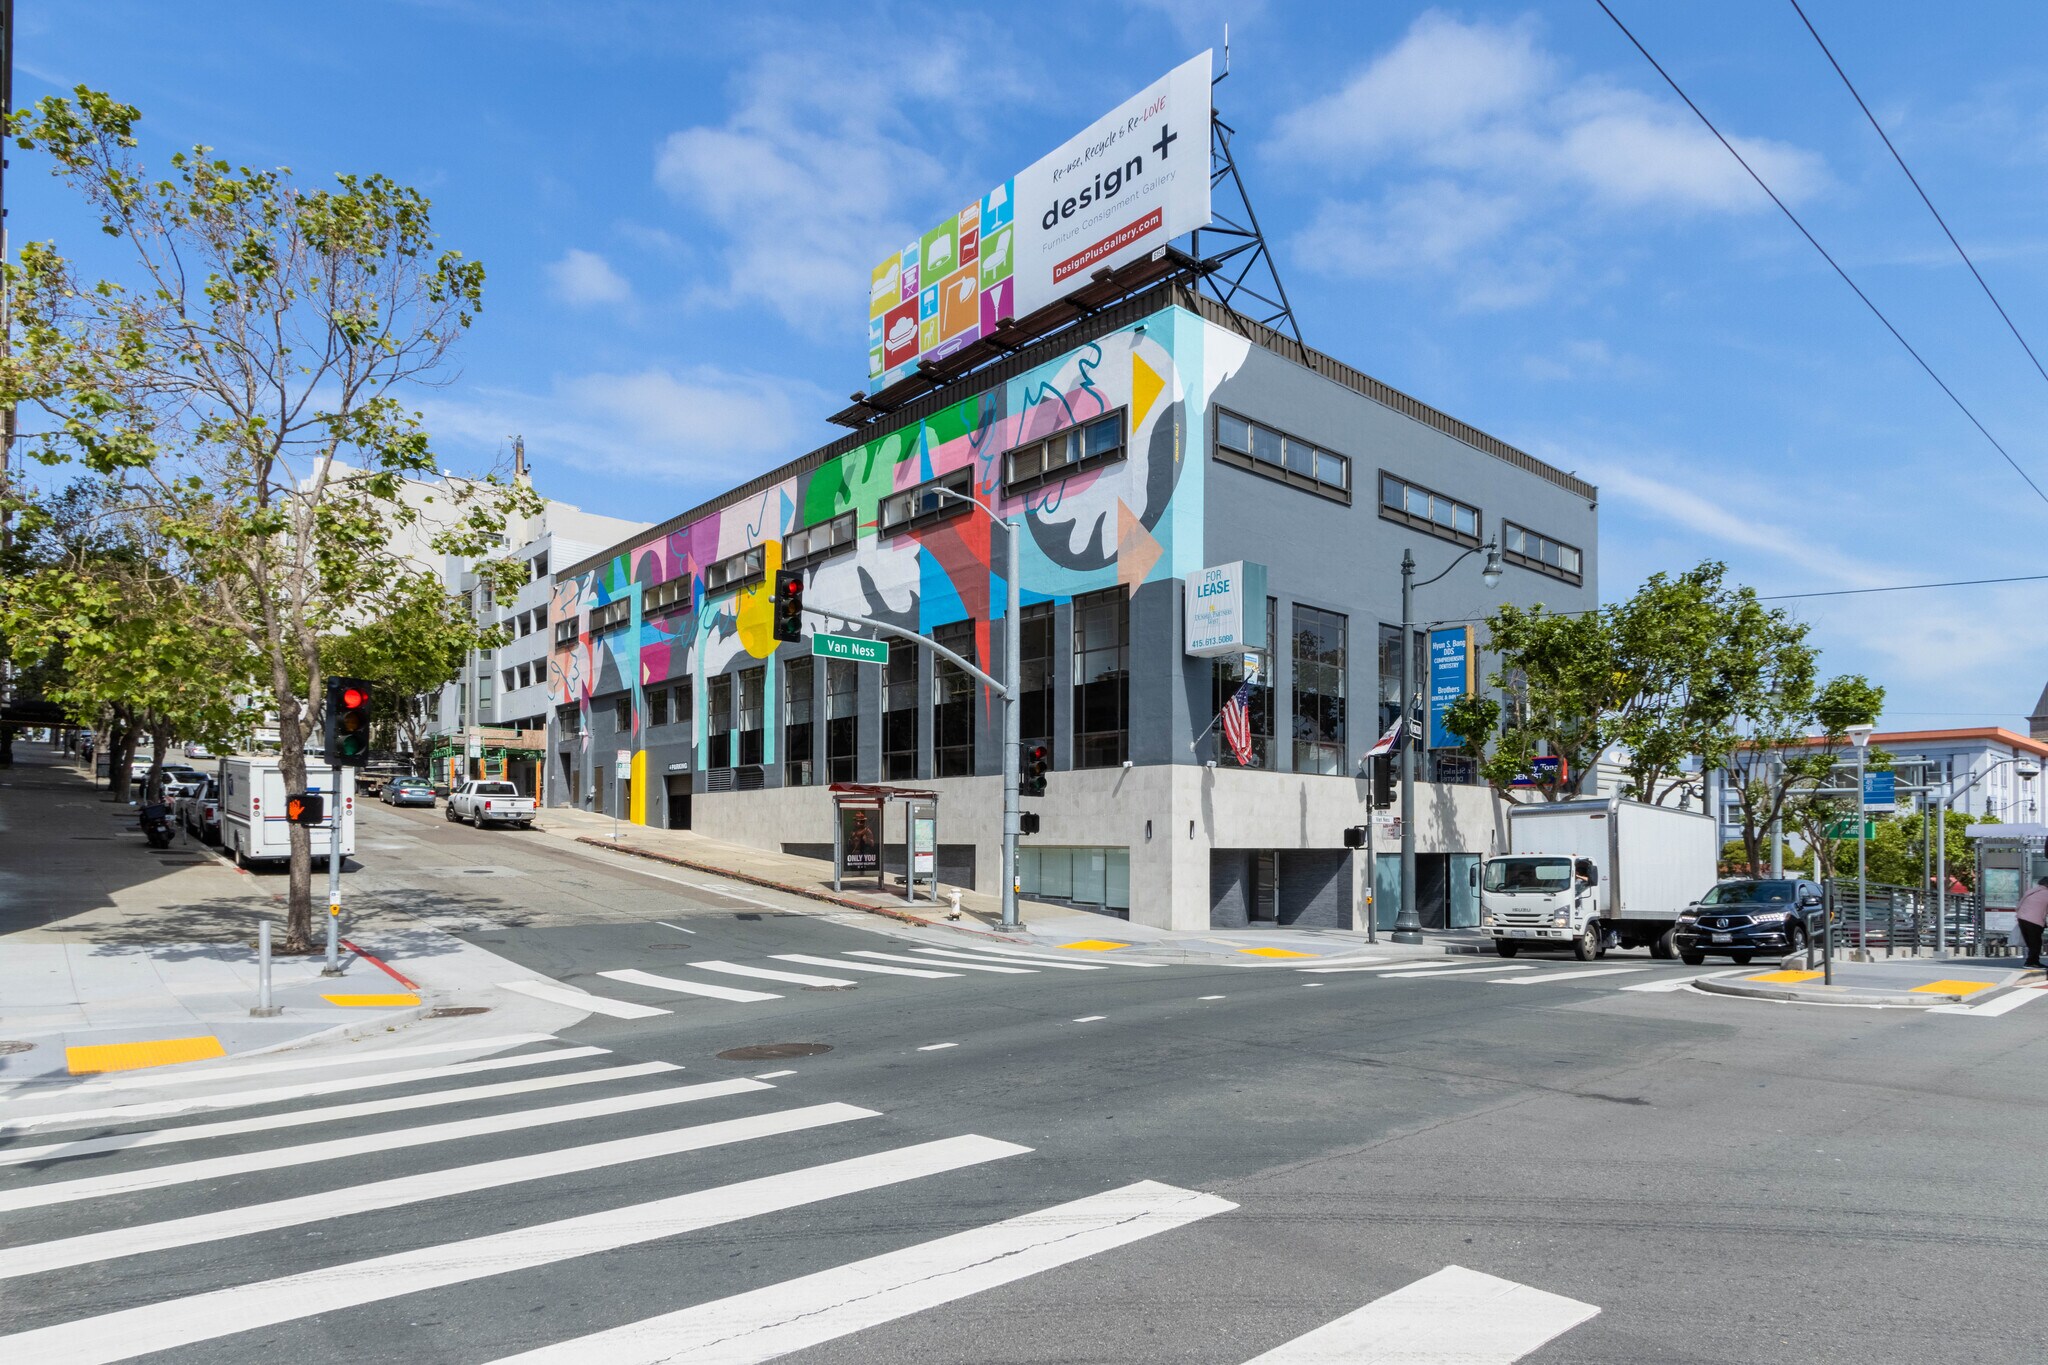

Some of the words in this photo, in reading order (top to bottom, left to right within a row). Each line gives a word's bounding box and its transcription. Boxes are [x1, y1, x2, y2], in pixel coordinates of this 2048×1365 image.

[1052, 156, 1083, 183] Re-use,
[1084, 131, 1117, 162] Recycle
[1127, 95, 1167, 134] Re-LOVE
[1042, 155, 1142, 231] design
[1042, 228, 1080, 254] Furniture
[1081, 190, 1140, 231] Consignment
[1142, 170, 1177, 196] Gallery
[1055, 215, 1160, 278] DesignPlusGallery.com
[1206, 569, 1222, 582] FOR
[1197, 579, 1230, 599] LEASE
[827, 639, 848, 654] Van
[852, 643, 875, 657] Ness
[1437, 686, 1460, 694] Brothers
[1513, 772, 1543, 781] DENST
[847, 854, 863, 862] ONLY
